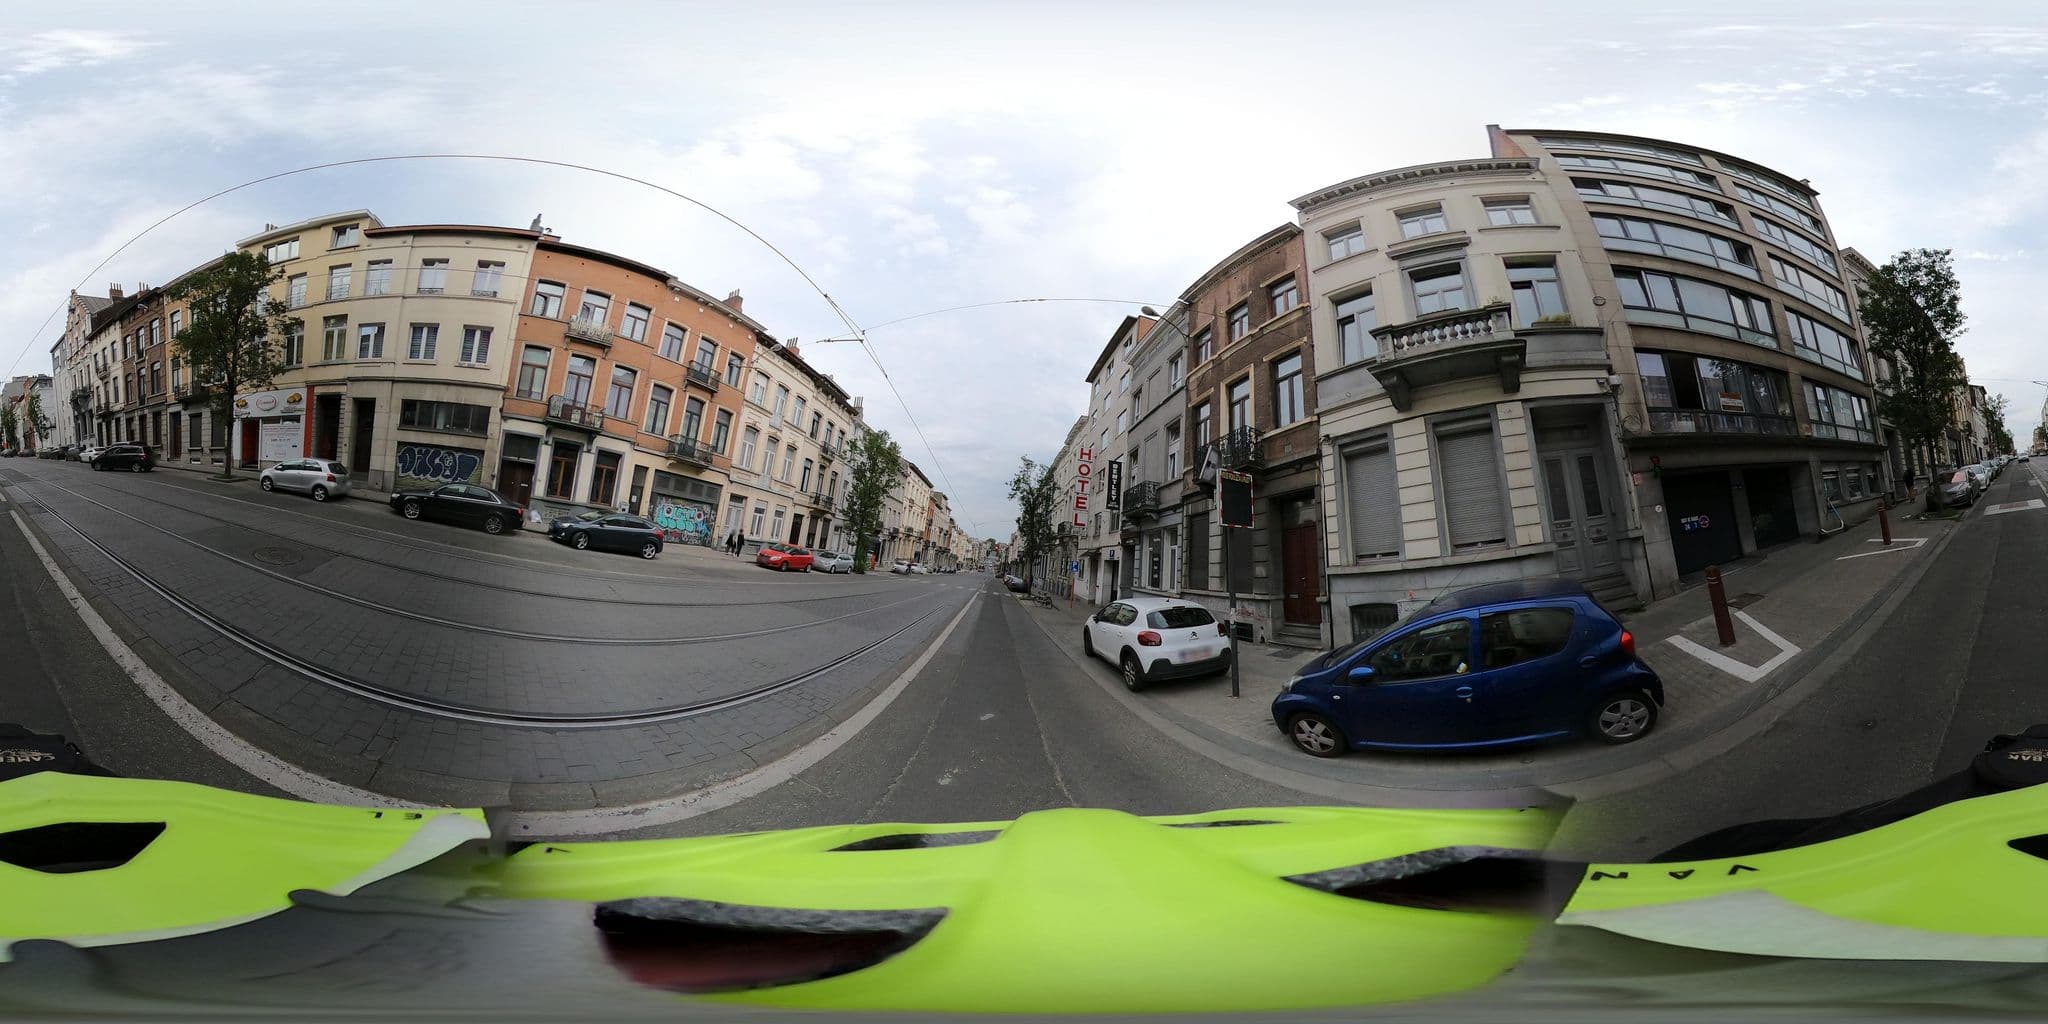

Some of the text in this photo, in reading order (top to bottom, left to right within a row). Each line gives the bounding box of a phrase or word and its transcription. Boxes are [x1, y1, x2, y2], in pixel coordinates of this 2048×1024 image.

[1073, 447, 1092, 527] HOTEL
[1111, 463, 1119, 501] BENTLEY
[1590, 864, 1760, 881] VAN
